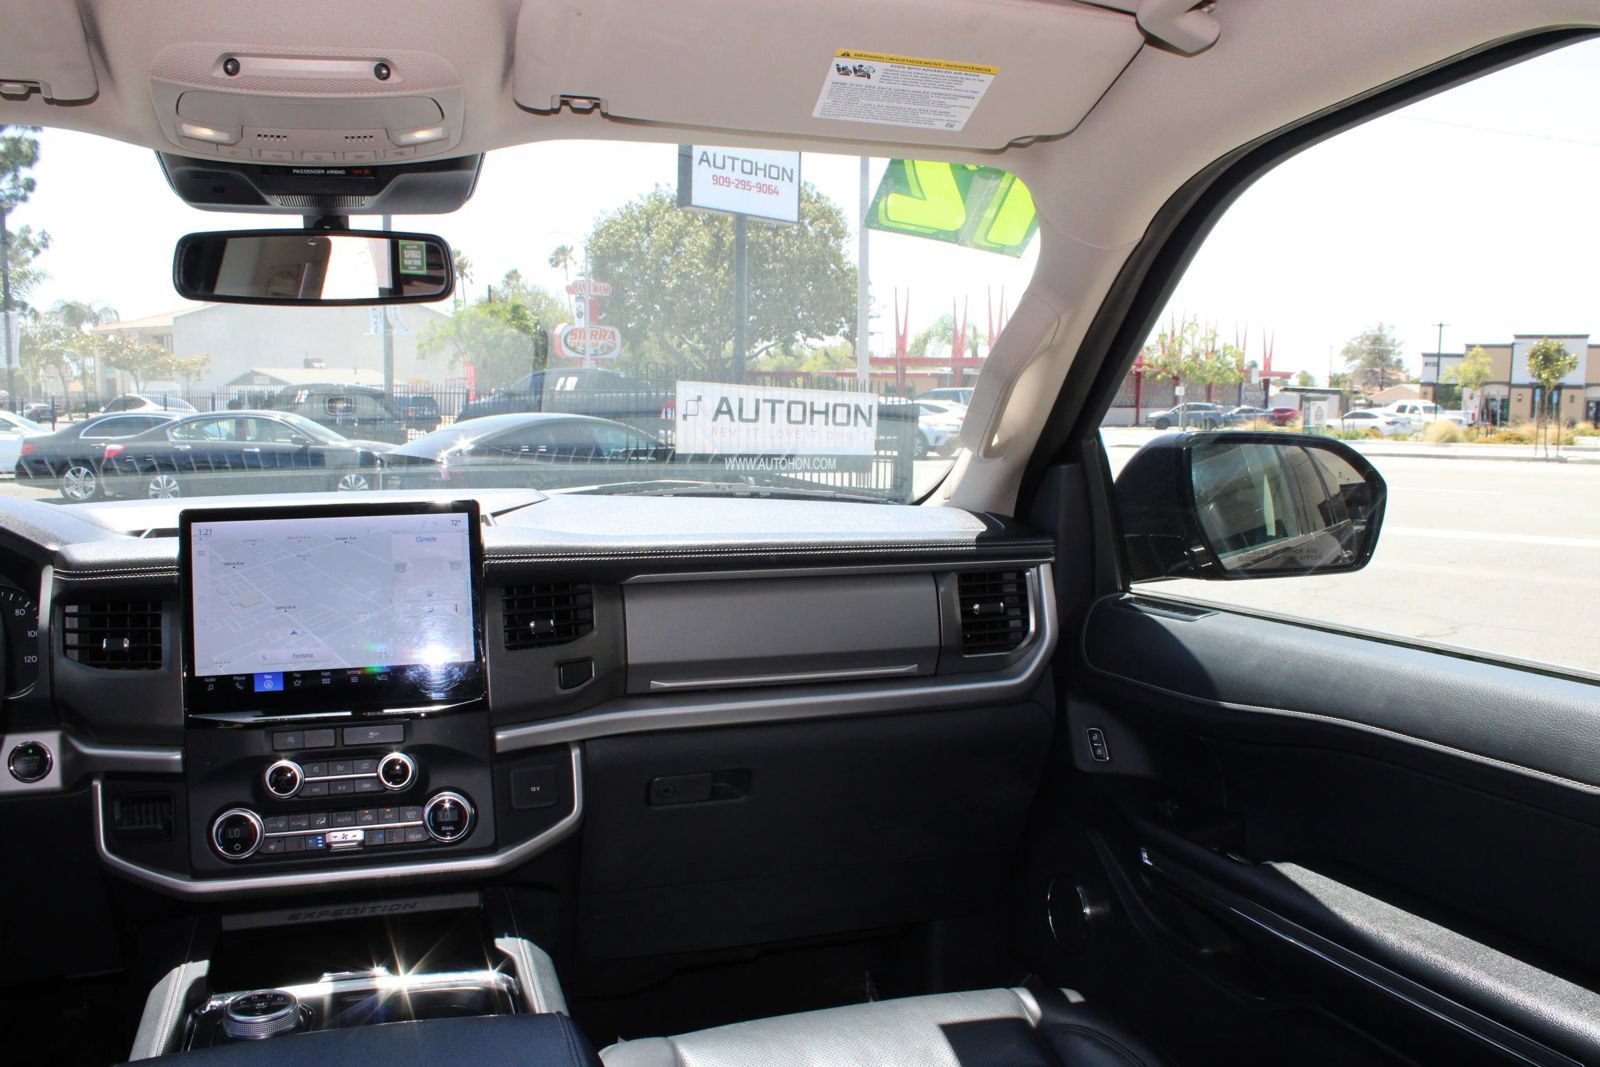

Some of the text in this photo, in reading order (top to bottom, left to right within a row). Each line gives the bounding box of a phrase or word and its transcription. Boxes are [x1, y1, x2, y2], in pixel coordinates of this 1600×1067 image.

[698, 150, 794, 184] AUTOHON
[712, 174, 780, 196] 909-295-9064
[570, 327, 616, 341] SIRRA
[712, 396, 873, 428] AUTOHON
[724, 457, 837, 471] WWW.AUTOHON.COM
[287, 901, 418, 922] EXPEDITION
